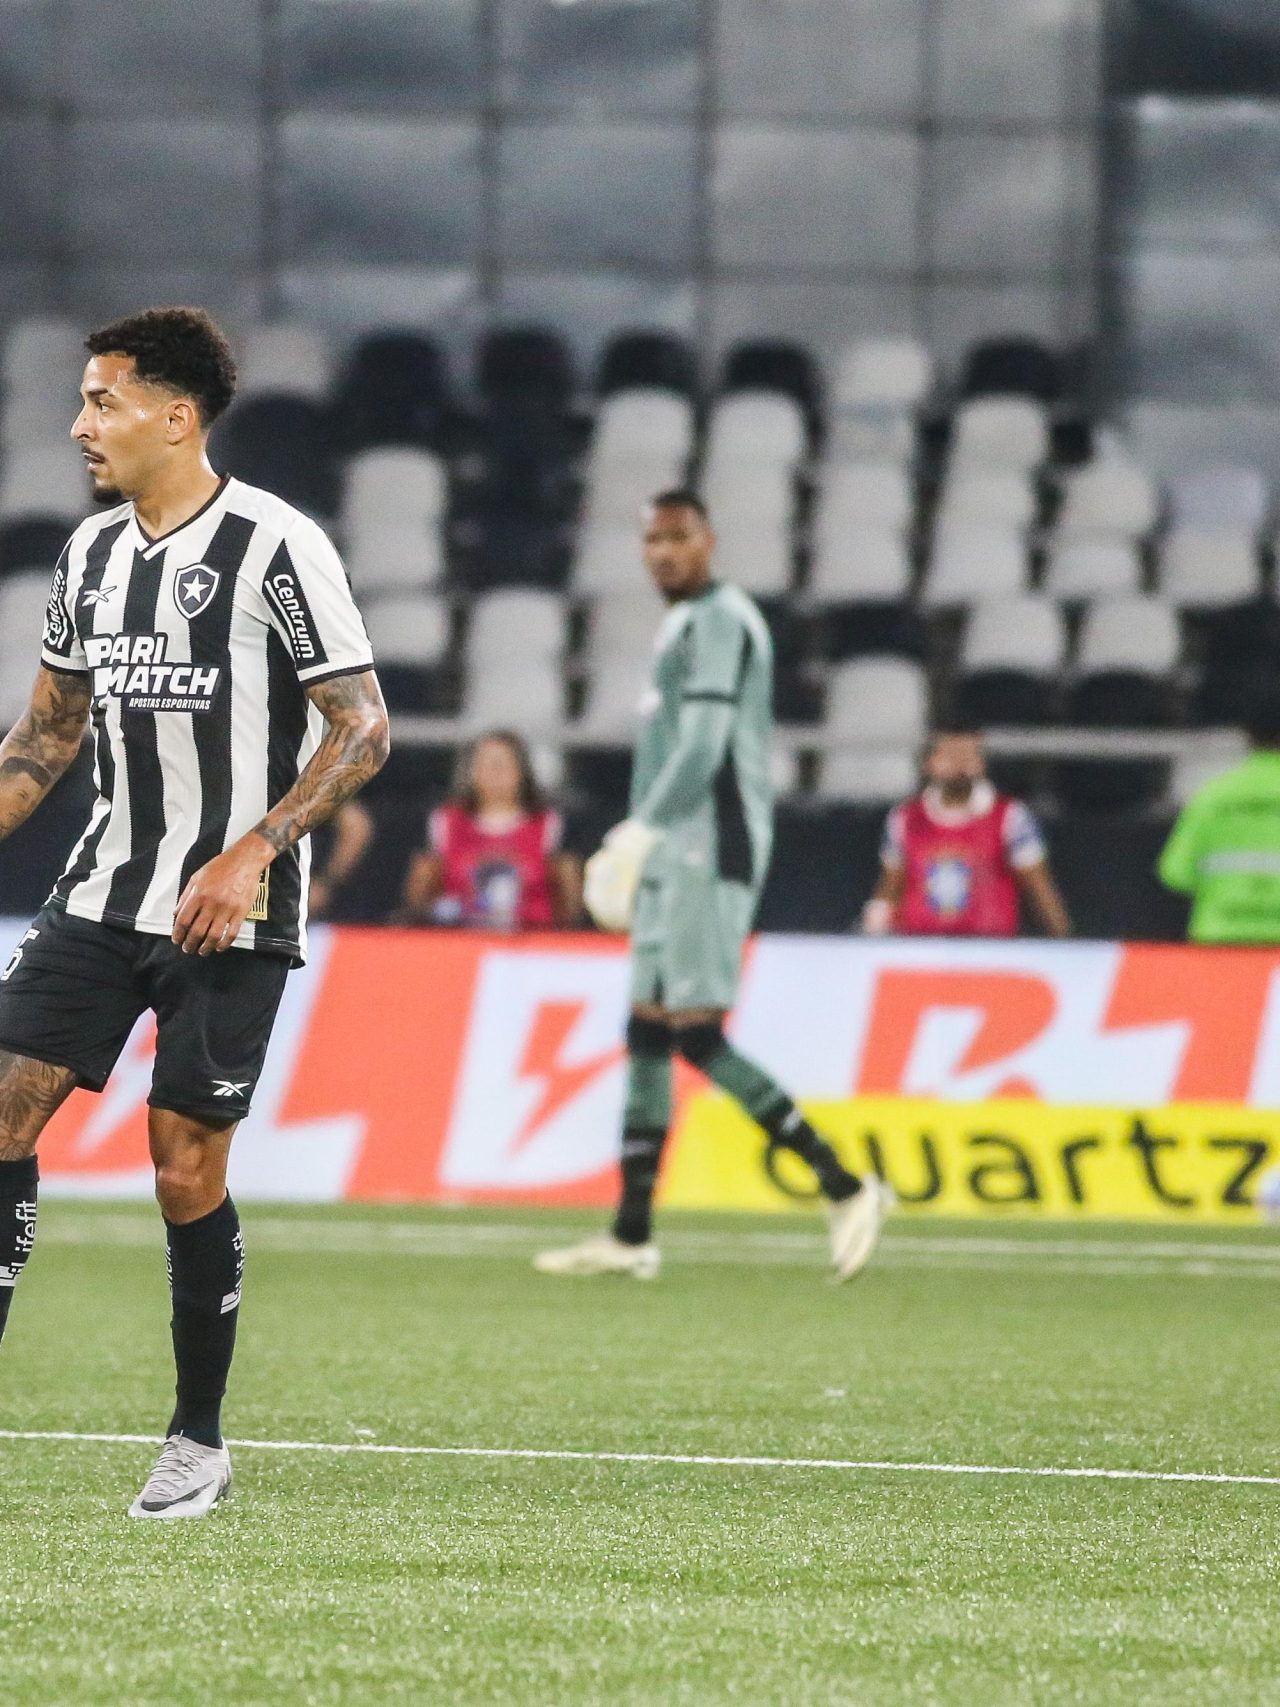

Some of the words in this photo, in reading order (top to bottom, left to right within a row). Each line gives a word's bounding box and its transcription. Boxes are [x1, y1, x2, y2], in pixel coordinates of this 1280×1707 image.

[273, 573, 315, 659] Centrum
[83, 635, 166, 668] PARI
[94, 665, 220, 697] MATCH
[128, 697, 160, 709] APOSTAS
[160, 698, 211, 711] ESPORTIVAS
